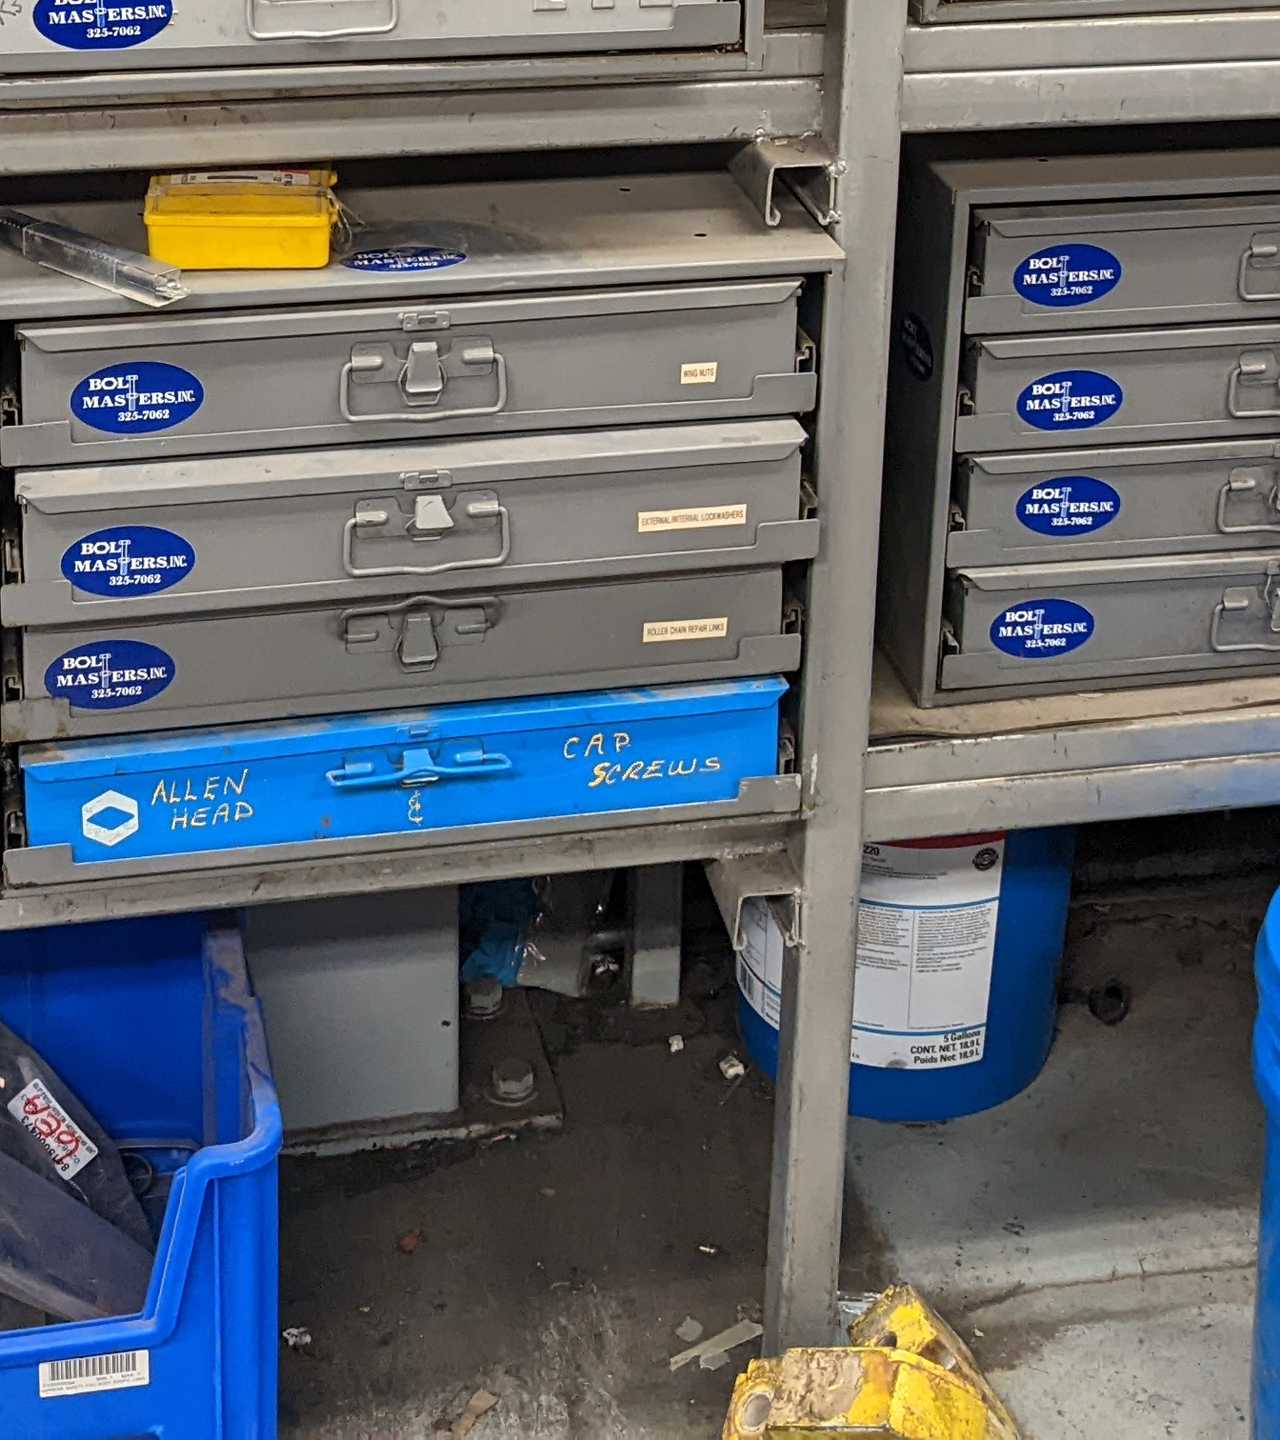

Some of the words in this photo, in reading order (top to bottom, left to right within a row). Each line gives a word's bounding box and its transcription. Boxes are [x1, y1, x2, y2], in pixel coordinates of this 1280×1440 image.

[86, 25, 140, 38] 325-7062
[117, 409, 169, 422] 325-7062
[108, 574, 161, 586] 325-7062
[91, 685, 142, 699] 325-7062
[563, 732, 631, 759] CAP
[588, 757, 721, 787] SCREWS
[152, 768, 248, 805] ALLEN
[171, 802, 254, 830] HEAD
